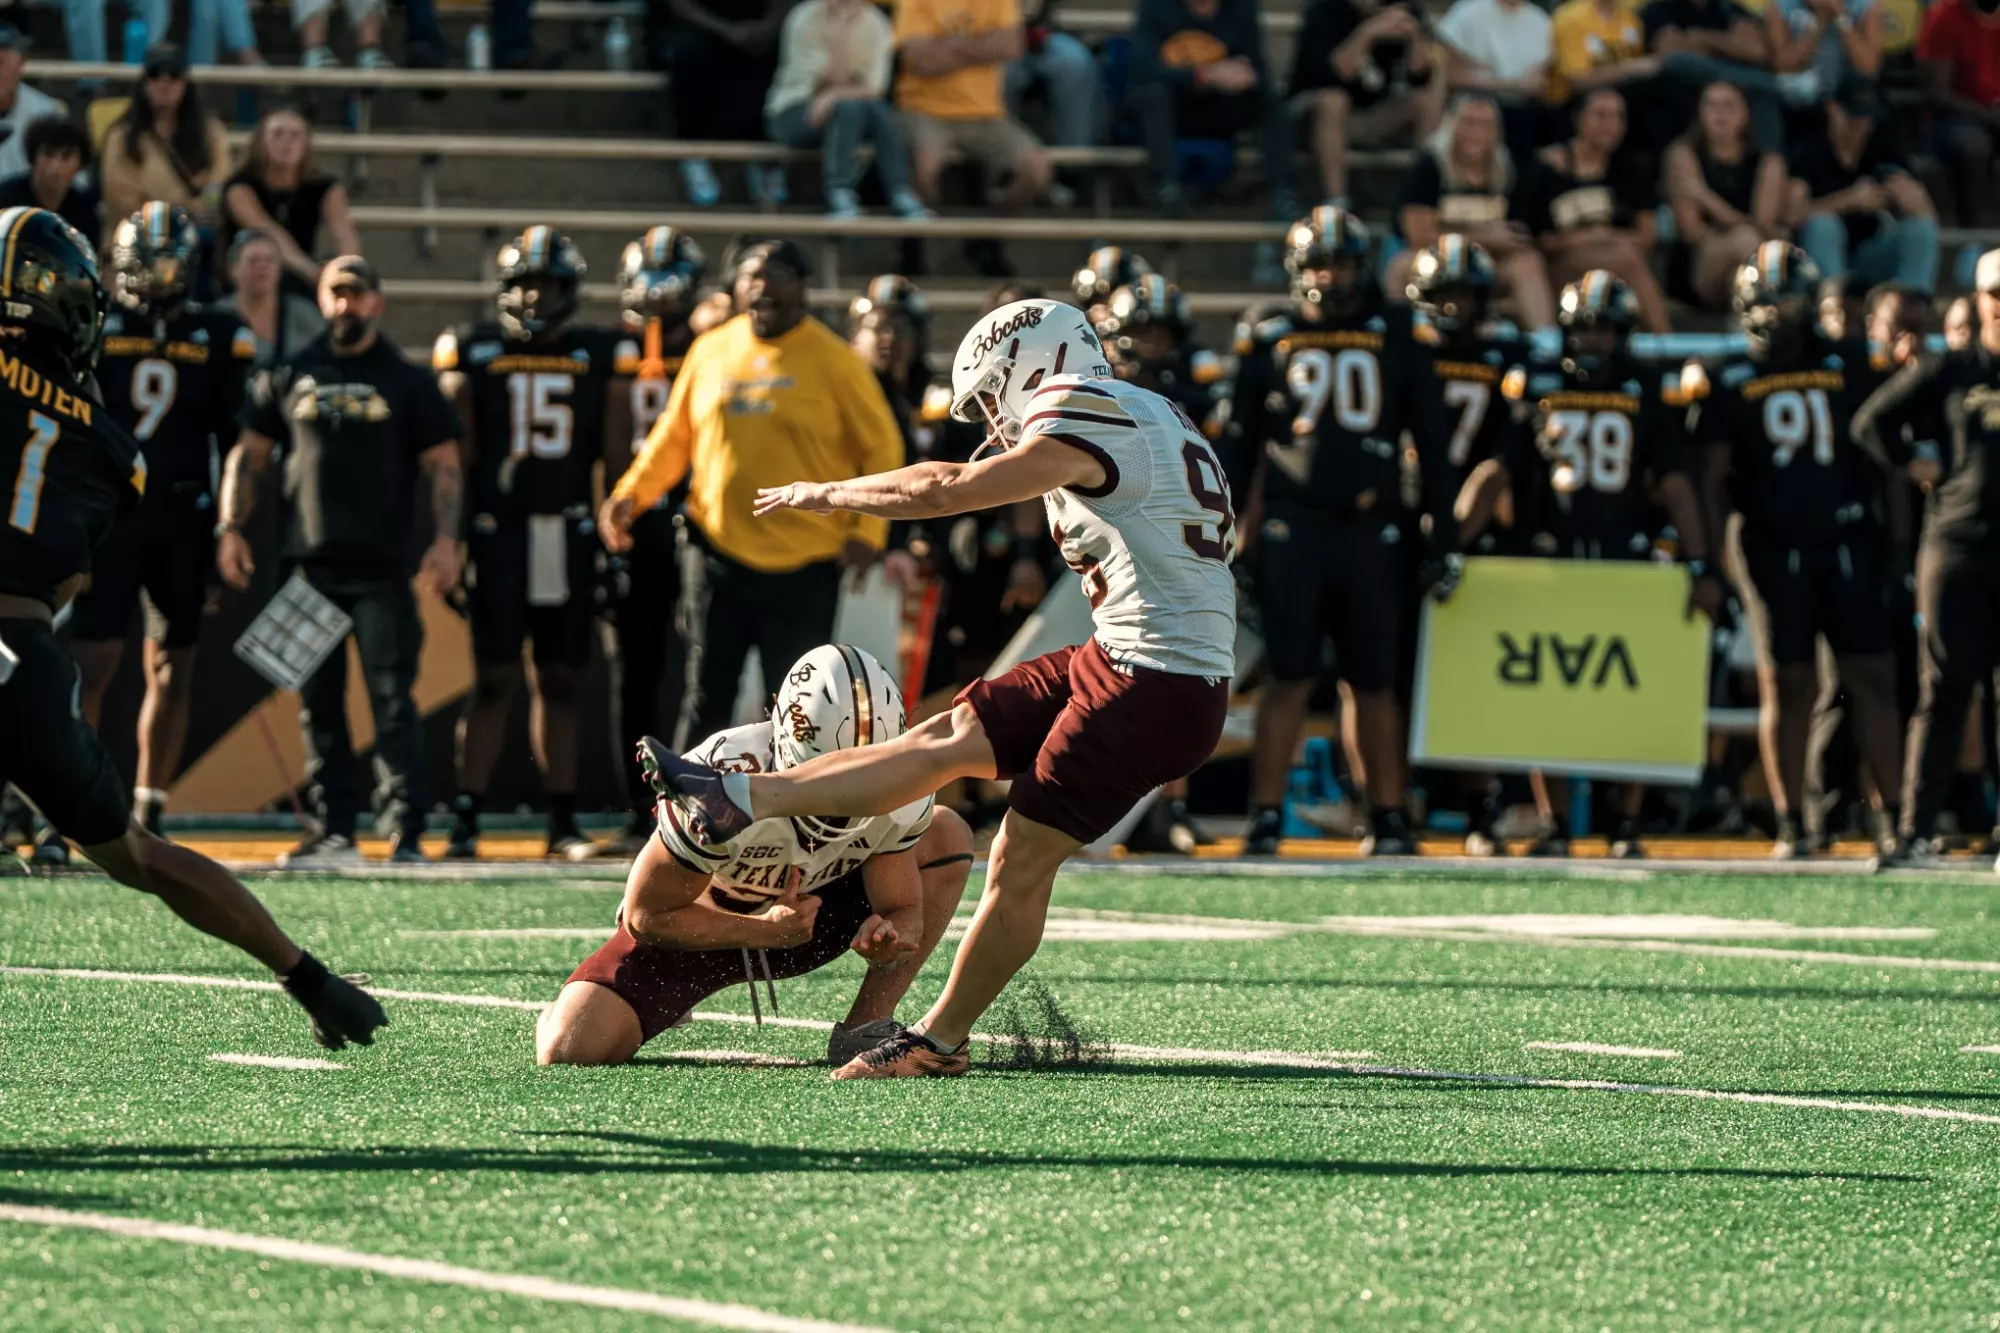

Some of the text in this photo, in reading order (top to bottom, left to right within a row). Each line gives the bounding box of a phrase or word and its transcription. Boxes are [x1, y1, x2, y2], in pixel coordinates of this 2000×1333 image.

[972, 306, 1044, 369] Bobcats
[131, 358, 178, 441] 9
[507, 372, 574, 460] 15
[1287, 348, 1381, 432] 90
[1443, 380, 1491, 466] 7
[1762, 389, 1835, 467] 91
[8, 408, 61, 535] 1
[1548, 410, 1634, 492] 38
[1180, 438, 1236, 565] 9
[1495, 630, 1641, 692] VAR
[740, 845, 784, 859] SBC
